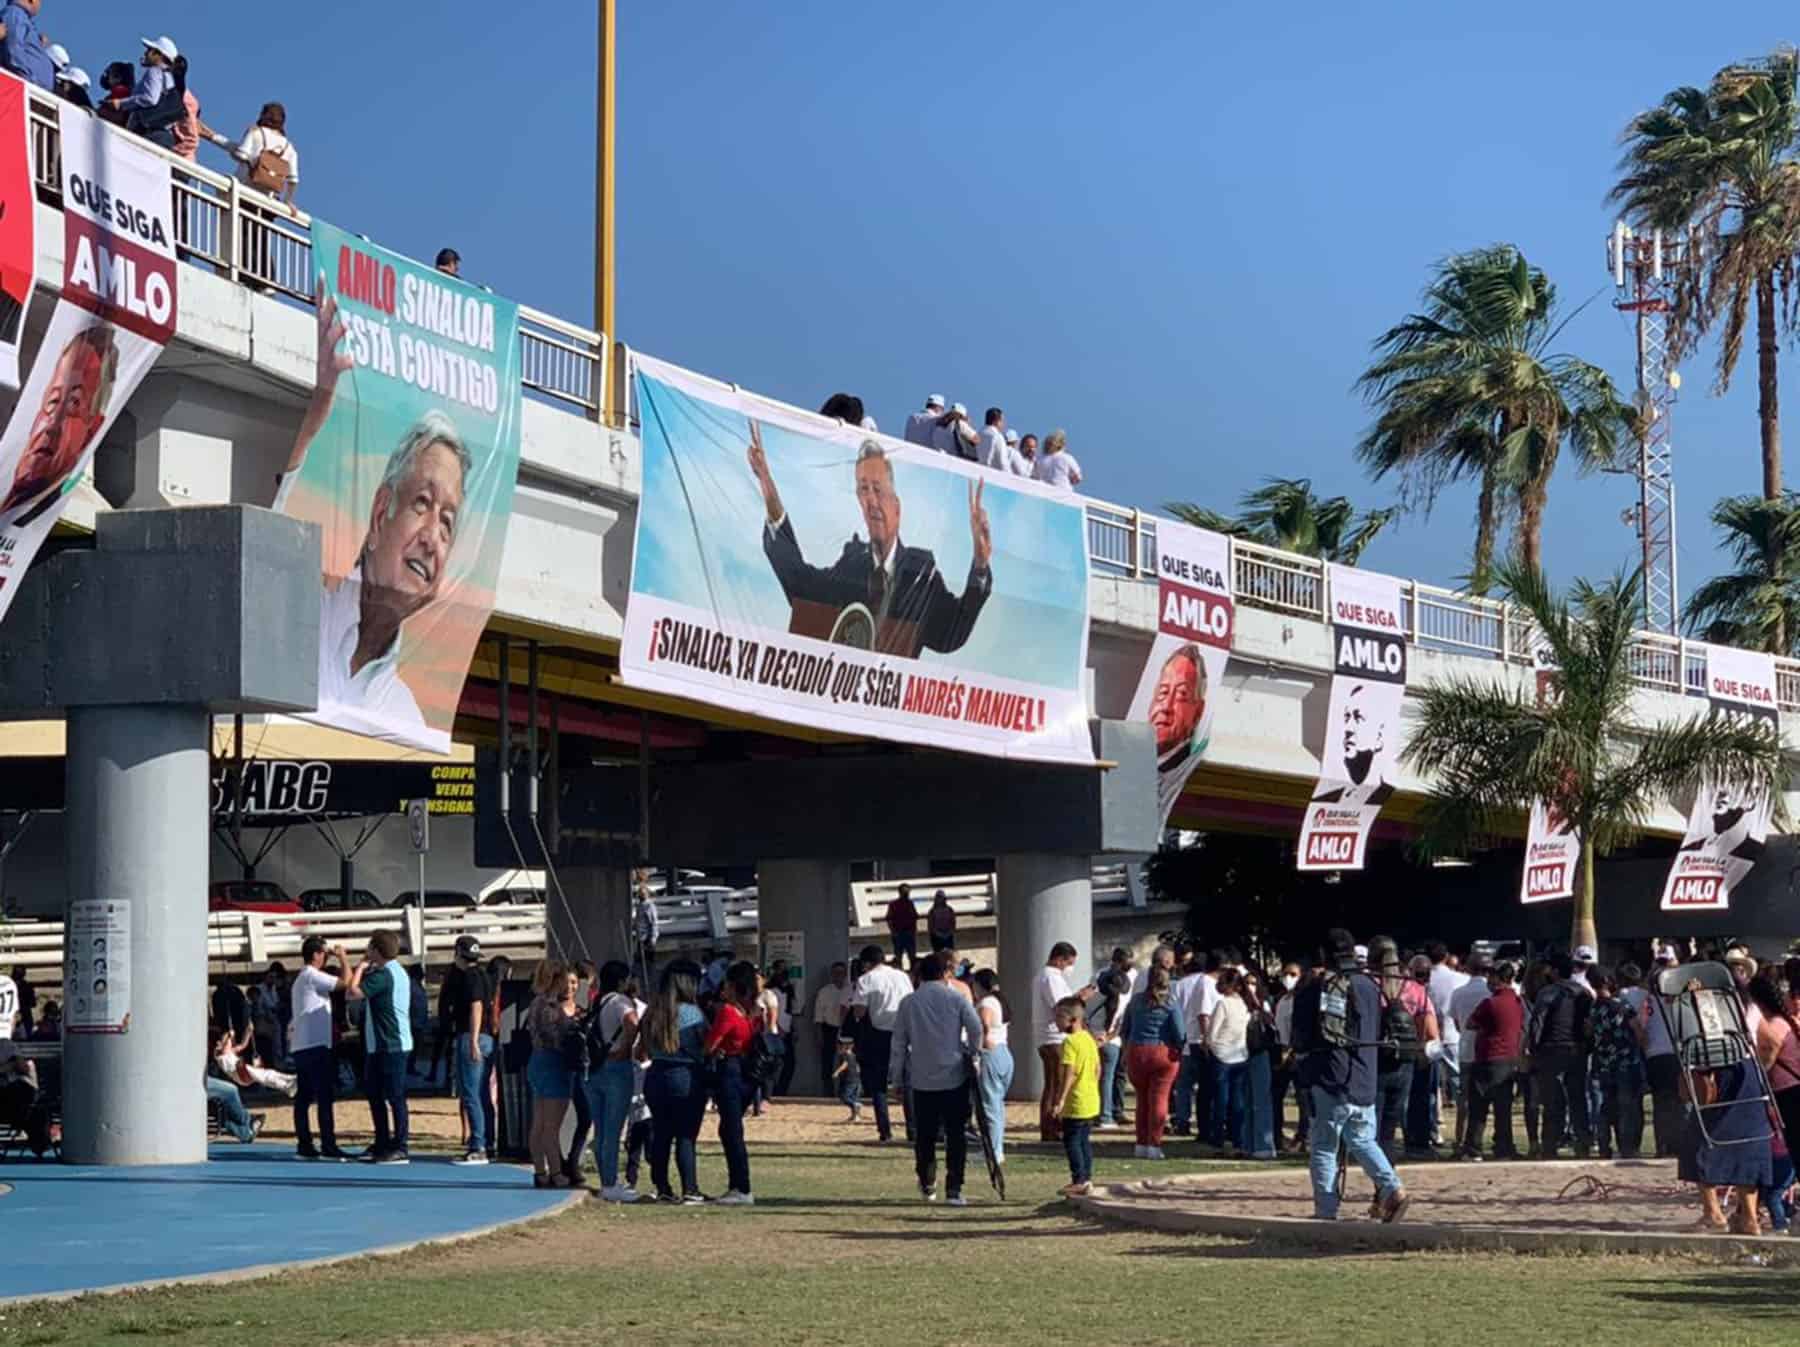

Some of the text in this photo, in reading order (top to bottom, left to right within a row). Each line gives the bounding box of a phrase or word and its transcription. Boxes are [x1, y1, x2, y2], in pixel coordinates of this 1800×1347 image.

[70, 174, 168, 248] QUE SIGA
[69, 234, 172, 325] AMLO
[402, 272, 495, 352] SINALOA
[399, 333, 498, 413] CONTIGO
[1162, 555, 1225, 590] QUE SIGA
[1162, 591, 1229, 638] AMLO
[1337, 601, 1398, 629] QUE SIGA
[1338, 635, 1401, 674] AMLO
[736, 639, 759, 682] YA
[758, 646, 834, 697] DECIDIÓ
[831, 661, 864, 704] QUE
[902, 674, 965, 720] ANDRÉS
[1713, 677, 1772, 703] QUE SIGA
[1308, 835, 1352, 861] AMLO
[1529, 866, 1561, 892] AMLO
[1673, 879, 1716, 901] AMLO
